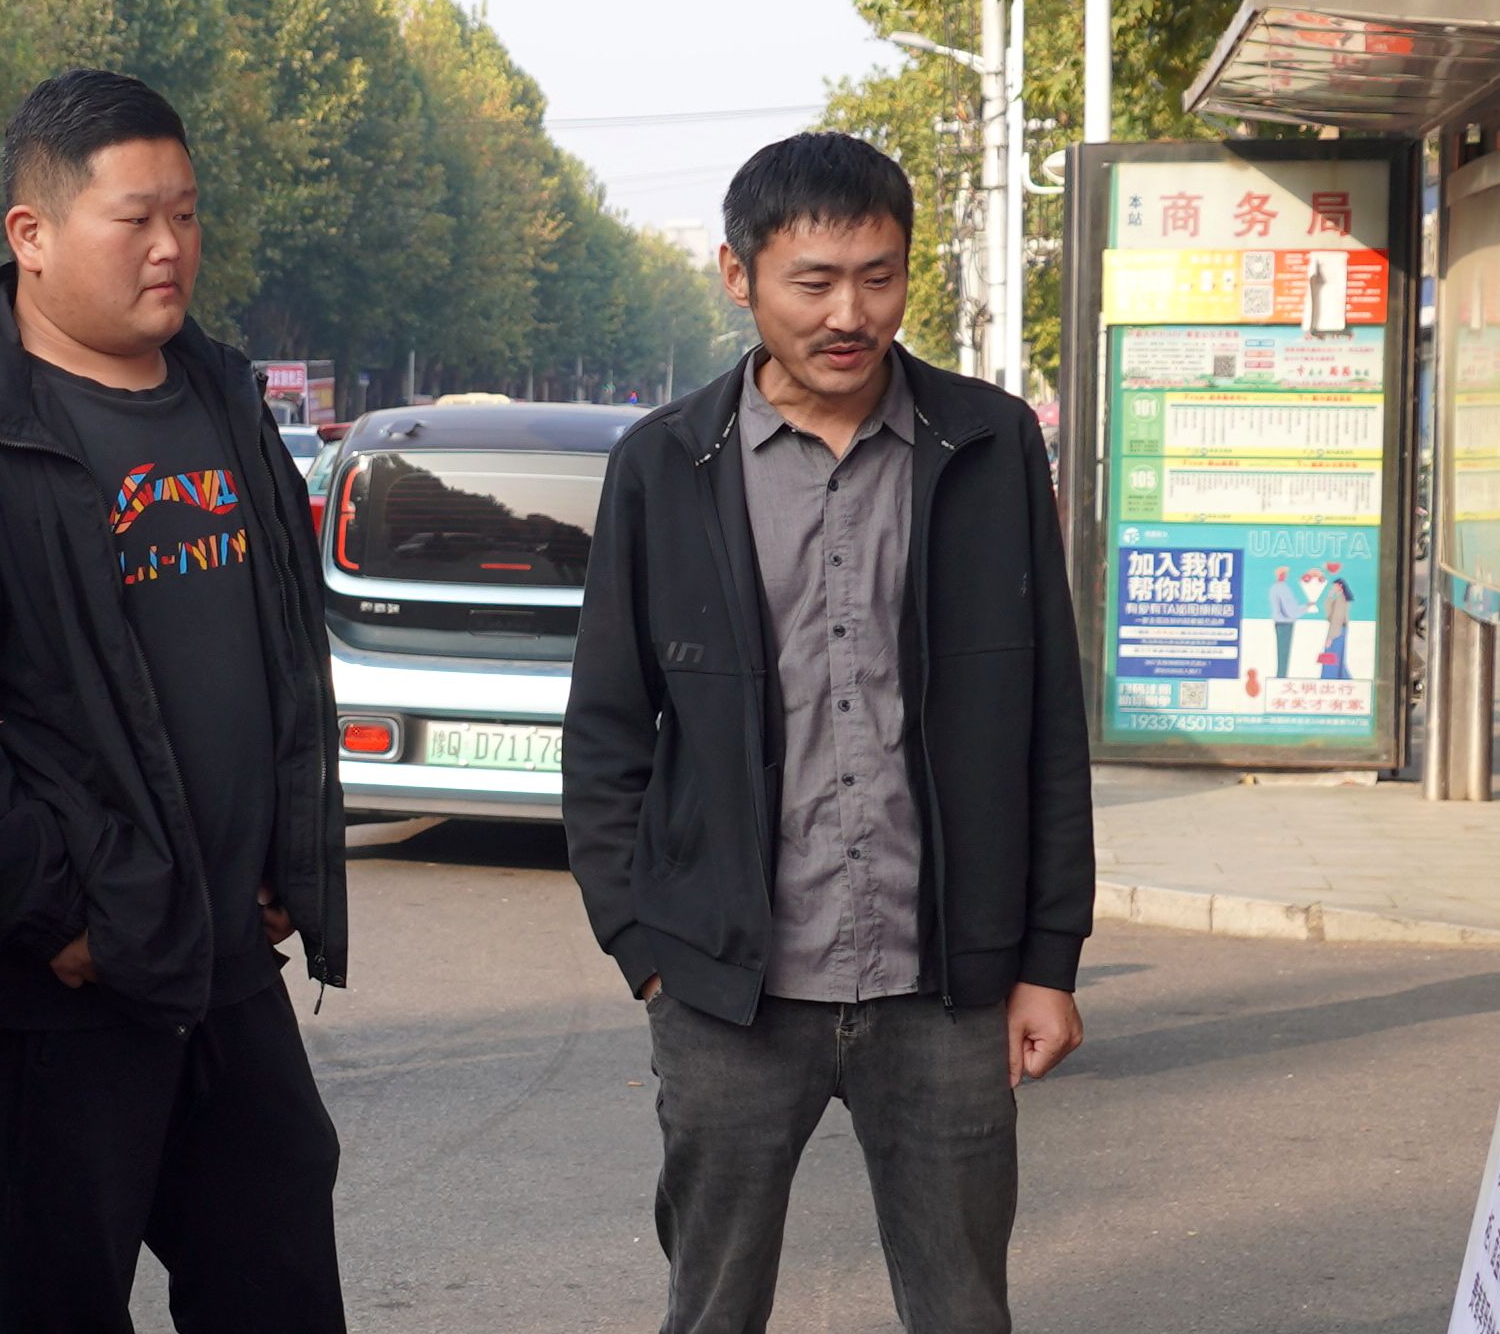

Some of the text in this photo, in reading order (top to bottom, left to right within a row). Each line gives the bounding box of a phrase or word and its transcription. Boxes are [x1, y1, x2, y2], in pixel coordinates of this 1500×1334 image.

[1159, 190, 1353, 239] 商务局
[1128, 551, 1233, 578] 加入我们
[1127, 577, 1232, 603] 帮你脱单
[1281, 682, 1356, 696] 文明出行
